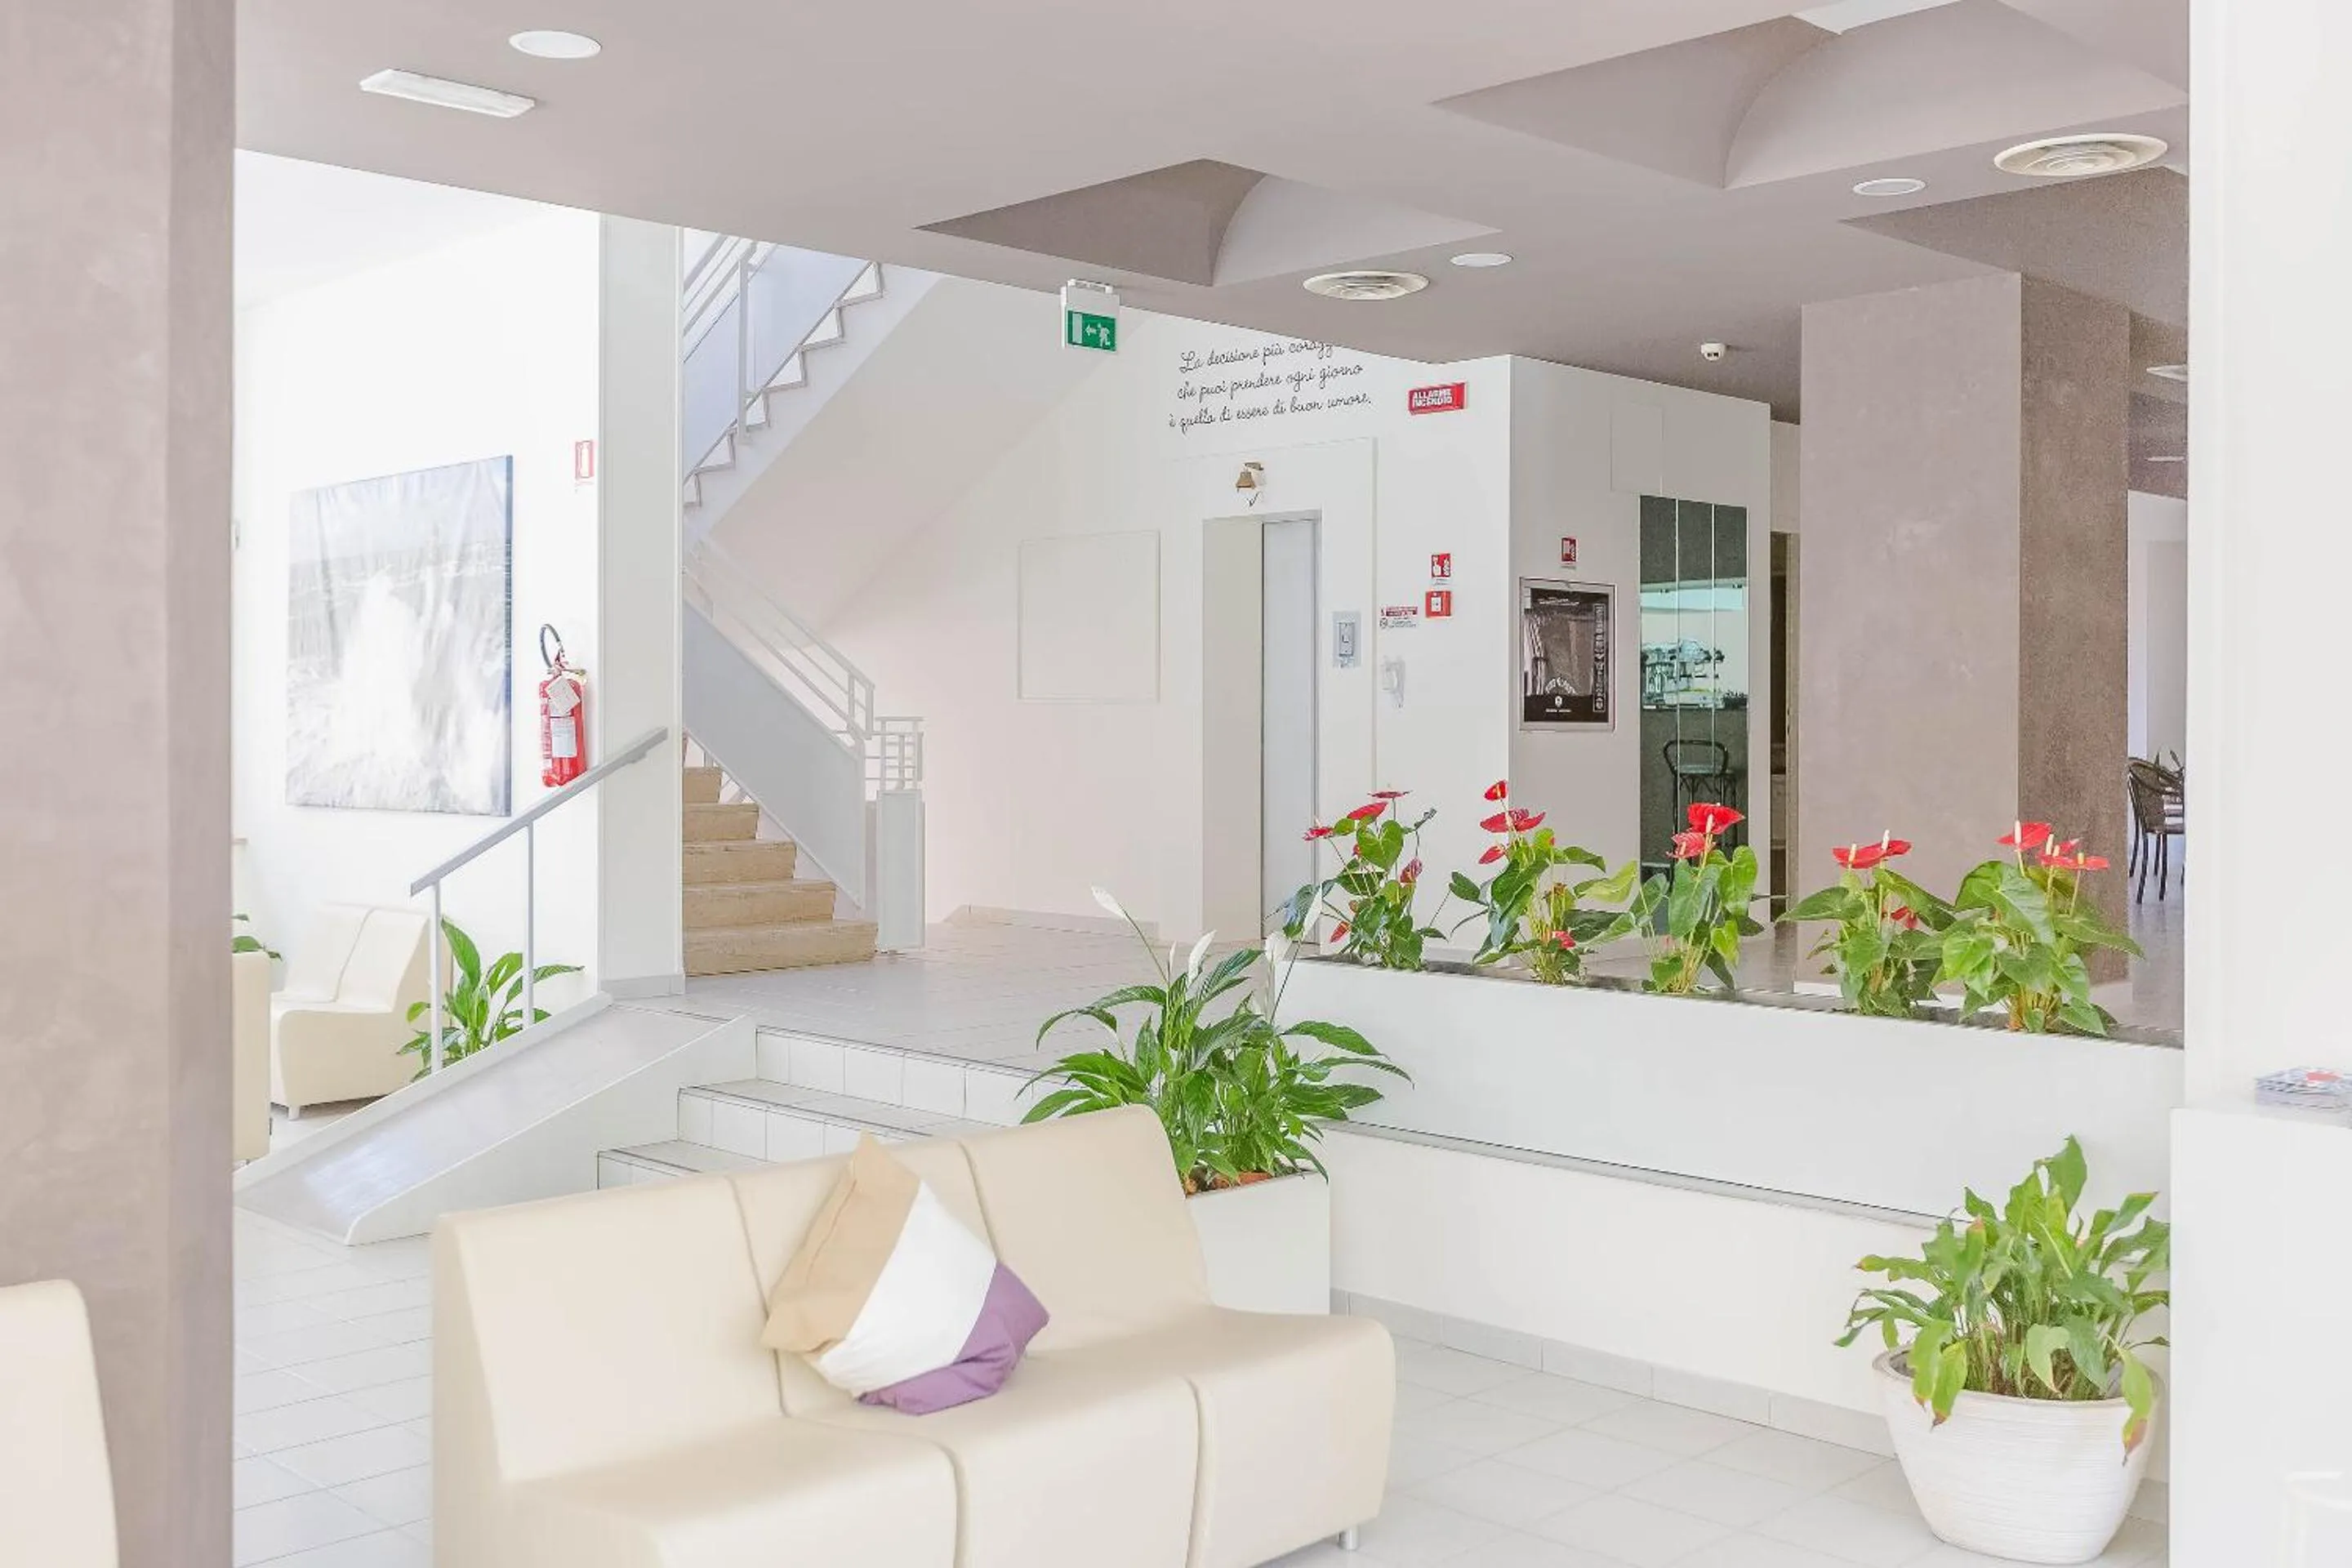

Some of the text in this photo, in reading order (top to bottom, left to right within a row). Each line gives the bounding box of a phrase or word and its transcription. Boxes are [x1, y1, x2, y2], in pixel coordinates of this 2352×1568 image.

[1179, 350, 1204, 374] La
[1208, 348, 1260, 367] decisione
[1263, 343, 1285, 366] più
[1178, 364, 1364, 403] che puoi prendere ogni giorno
[1413, 389, 1451, 399] ALLARME
[1179, 408, 1216, 435] quella
[1219, 406, 1232, 422] di
[1236, 406, 1269, 421] essere
[1272, 399, 1287, 415] di
[1290, 396, 1322, 413] buon
[1327, 392, 1372, 409] umore.
[1412, 397, 1453, 408] INCENDIO
